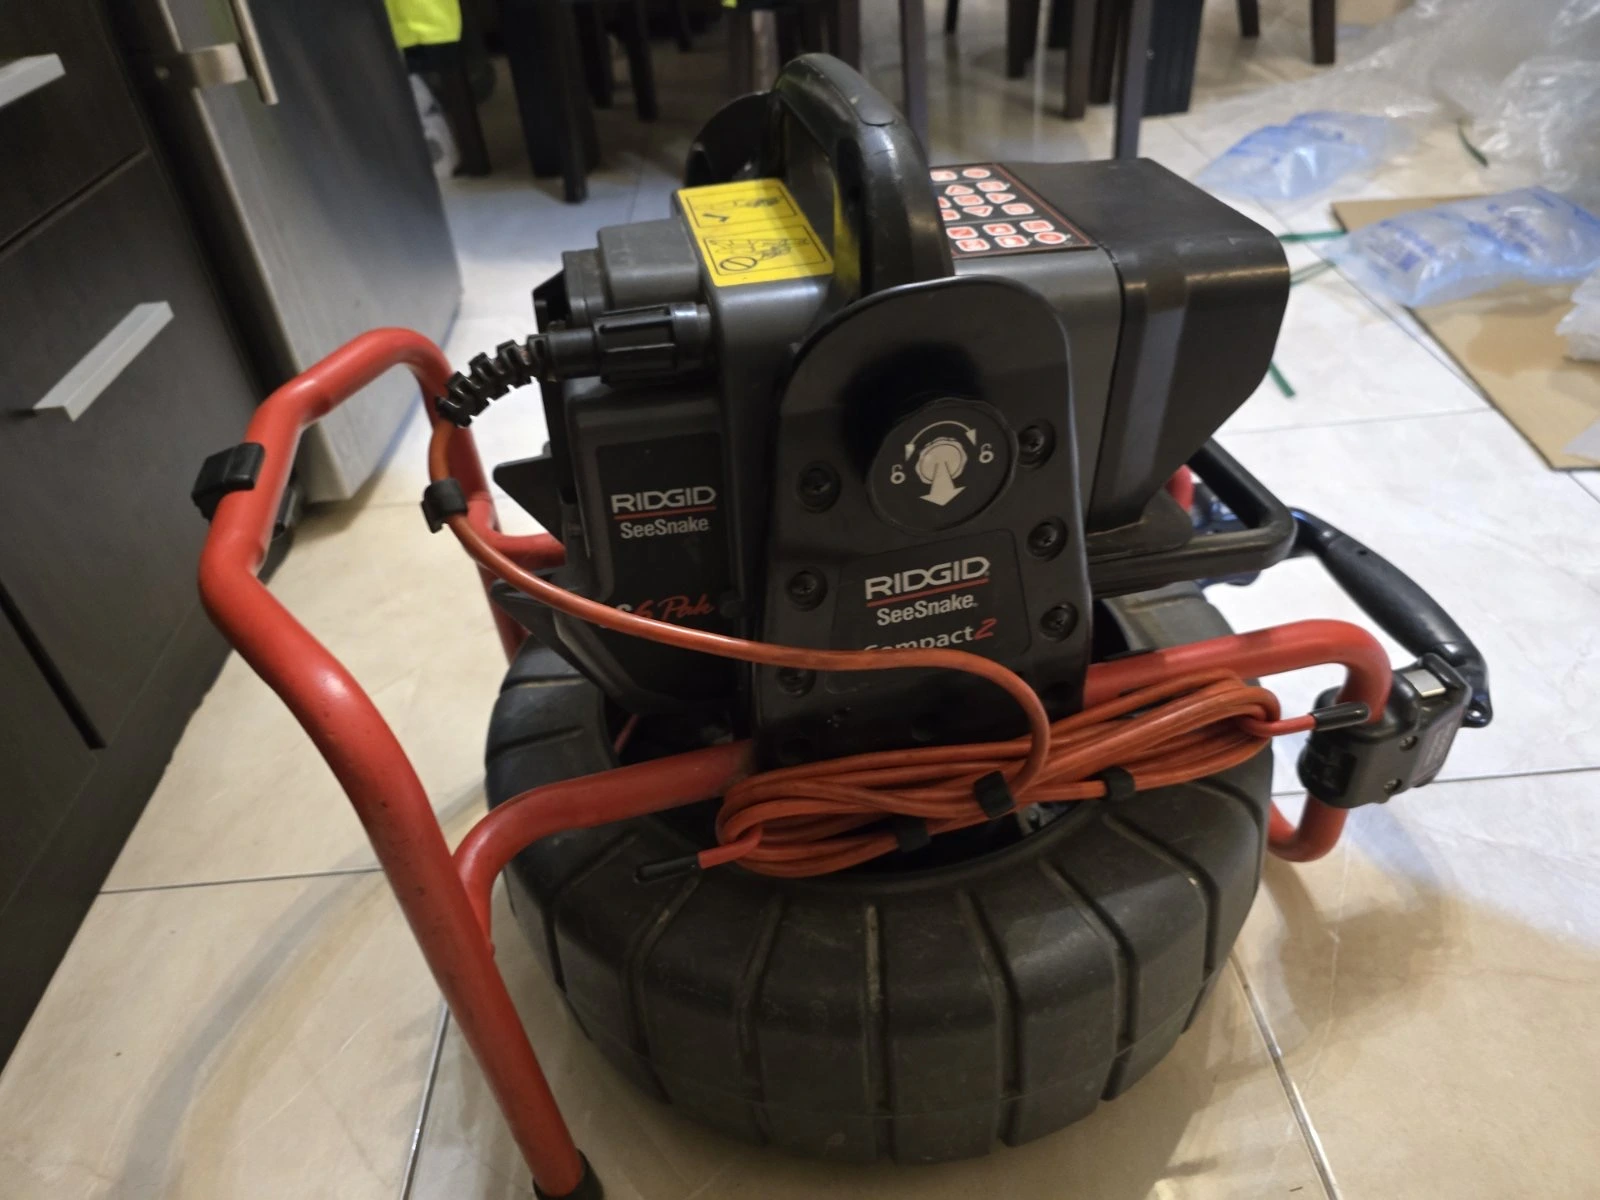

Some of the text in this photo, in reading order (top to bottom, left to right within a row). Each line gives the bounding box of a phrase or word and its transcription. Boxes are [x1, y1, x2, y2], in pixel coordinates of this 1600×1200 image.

[611, 486, 717, 514] RIDGID
[620, 516, 710, 539] SeeSnake
[865, 556, 991, 600] RIDGID
[877, 594, 975, 626] SeeSnake
[864, 618, 997, 650] mpact2
